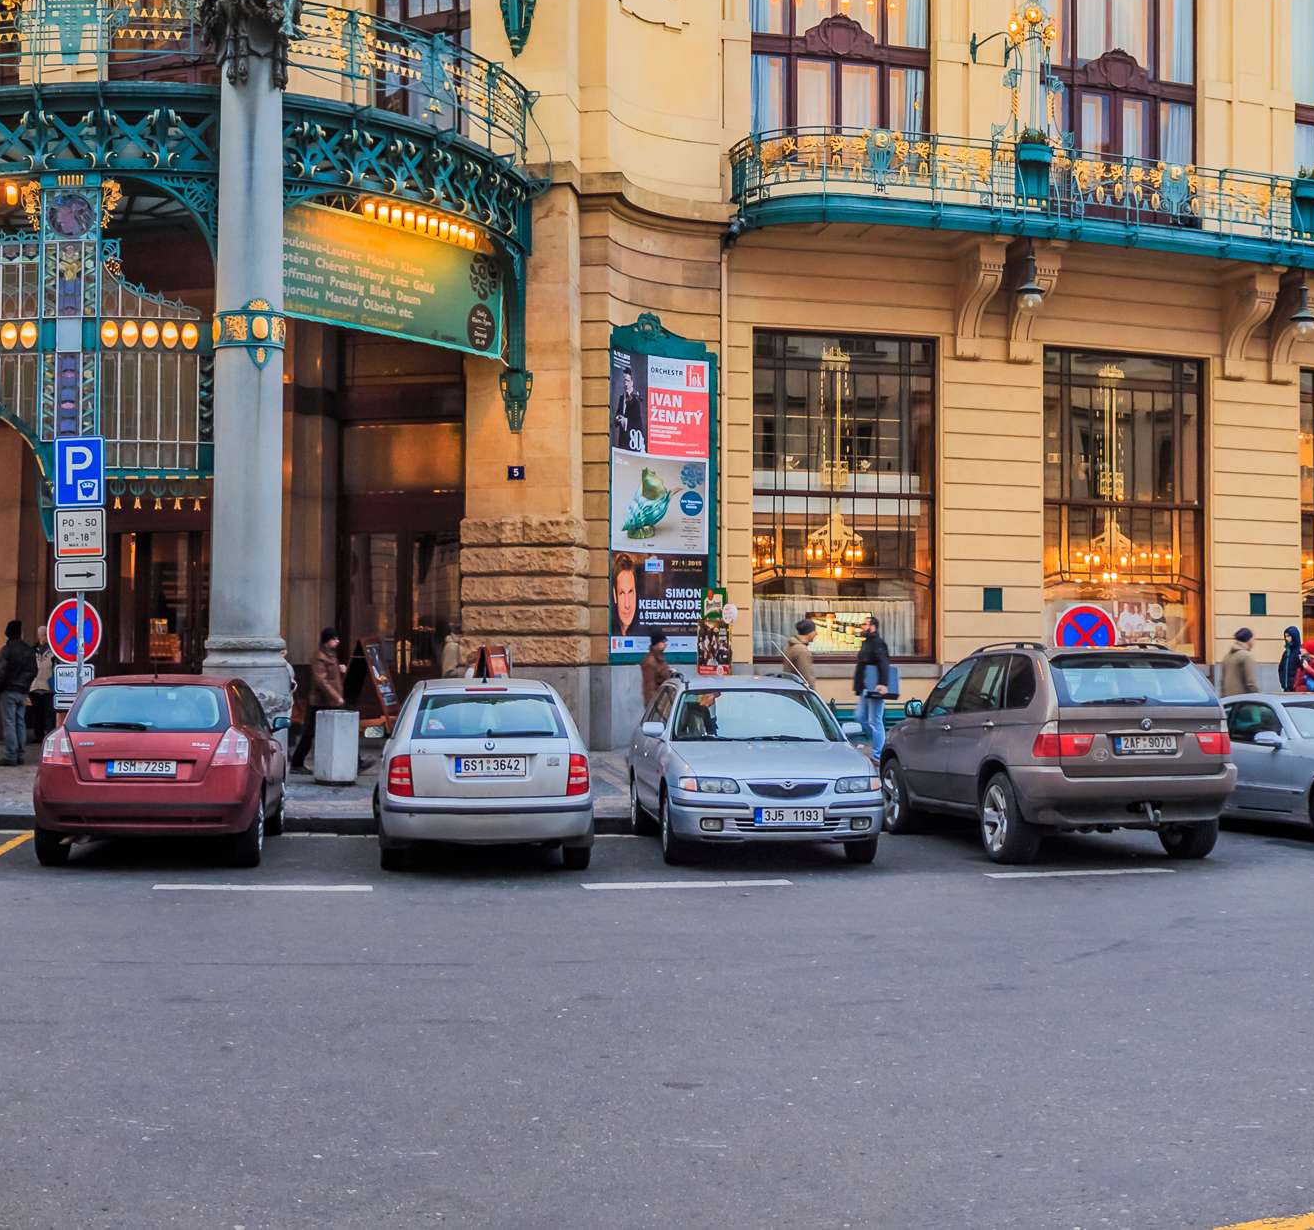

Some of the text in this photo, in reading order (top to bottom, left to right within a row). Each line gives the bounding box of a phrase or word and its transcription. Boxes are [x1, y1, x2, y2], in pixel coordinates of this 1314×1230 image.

[283, 236, 362, 262] oulouse-Lautrec
[283, 252, 309, 266] otěra
[354, 265, 386, 285] Tiffany
[283, 267, 324, 284] offmann
[330, 275, 365, 296] Preissig
[396, 290, 421, 306] Daum
[283, 284, 319, 300] jorelle
[326, 290, 359, 307] Marold
[363, 298, 397, 315] Olbrich
[399, 309, 415, 319] etc.
[689, 366, 702, 387] fok
[651, 393, 682, 408] IVAN
[651, 407, 703, 425] ŽENATÝ
[66, 446, 93, 485] P
[513, 468, 519, 476] 5
[62, 519, 74, 527] PO
[85, 518, 97, 527] SO
[666, 588, 701, 598] SIMON
[638, 599, 701, 610] KEENLYSIDE
[645, 611, 672, 620] ŠTEFAN
[674, 611, 702, 620] KOCÁN
[1124, 737, 1172, 749] 2AF 9070
[117, 762, 171, 772] 1SM 7295
[463, 759, 520, 771] 6S1 3642
[765, 810, 819, 821] 3J5 1193
